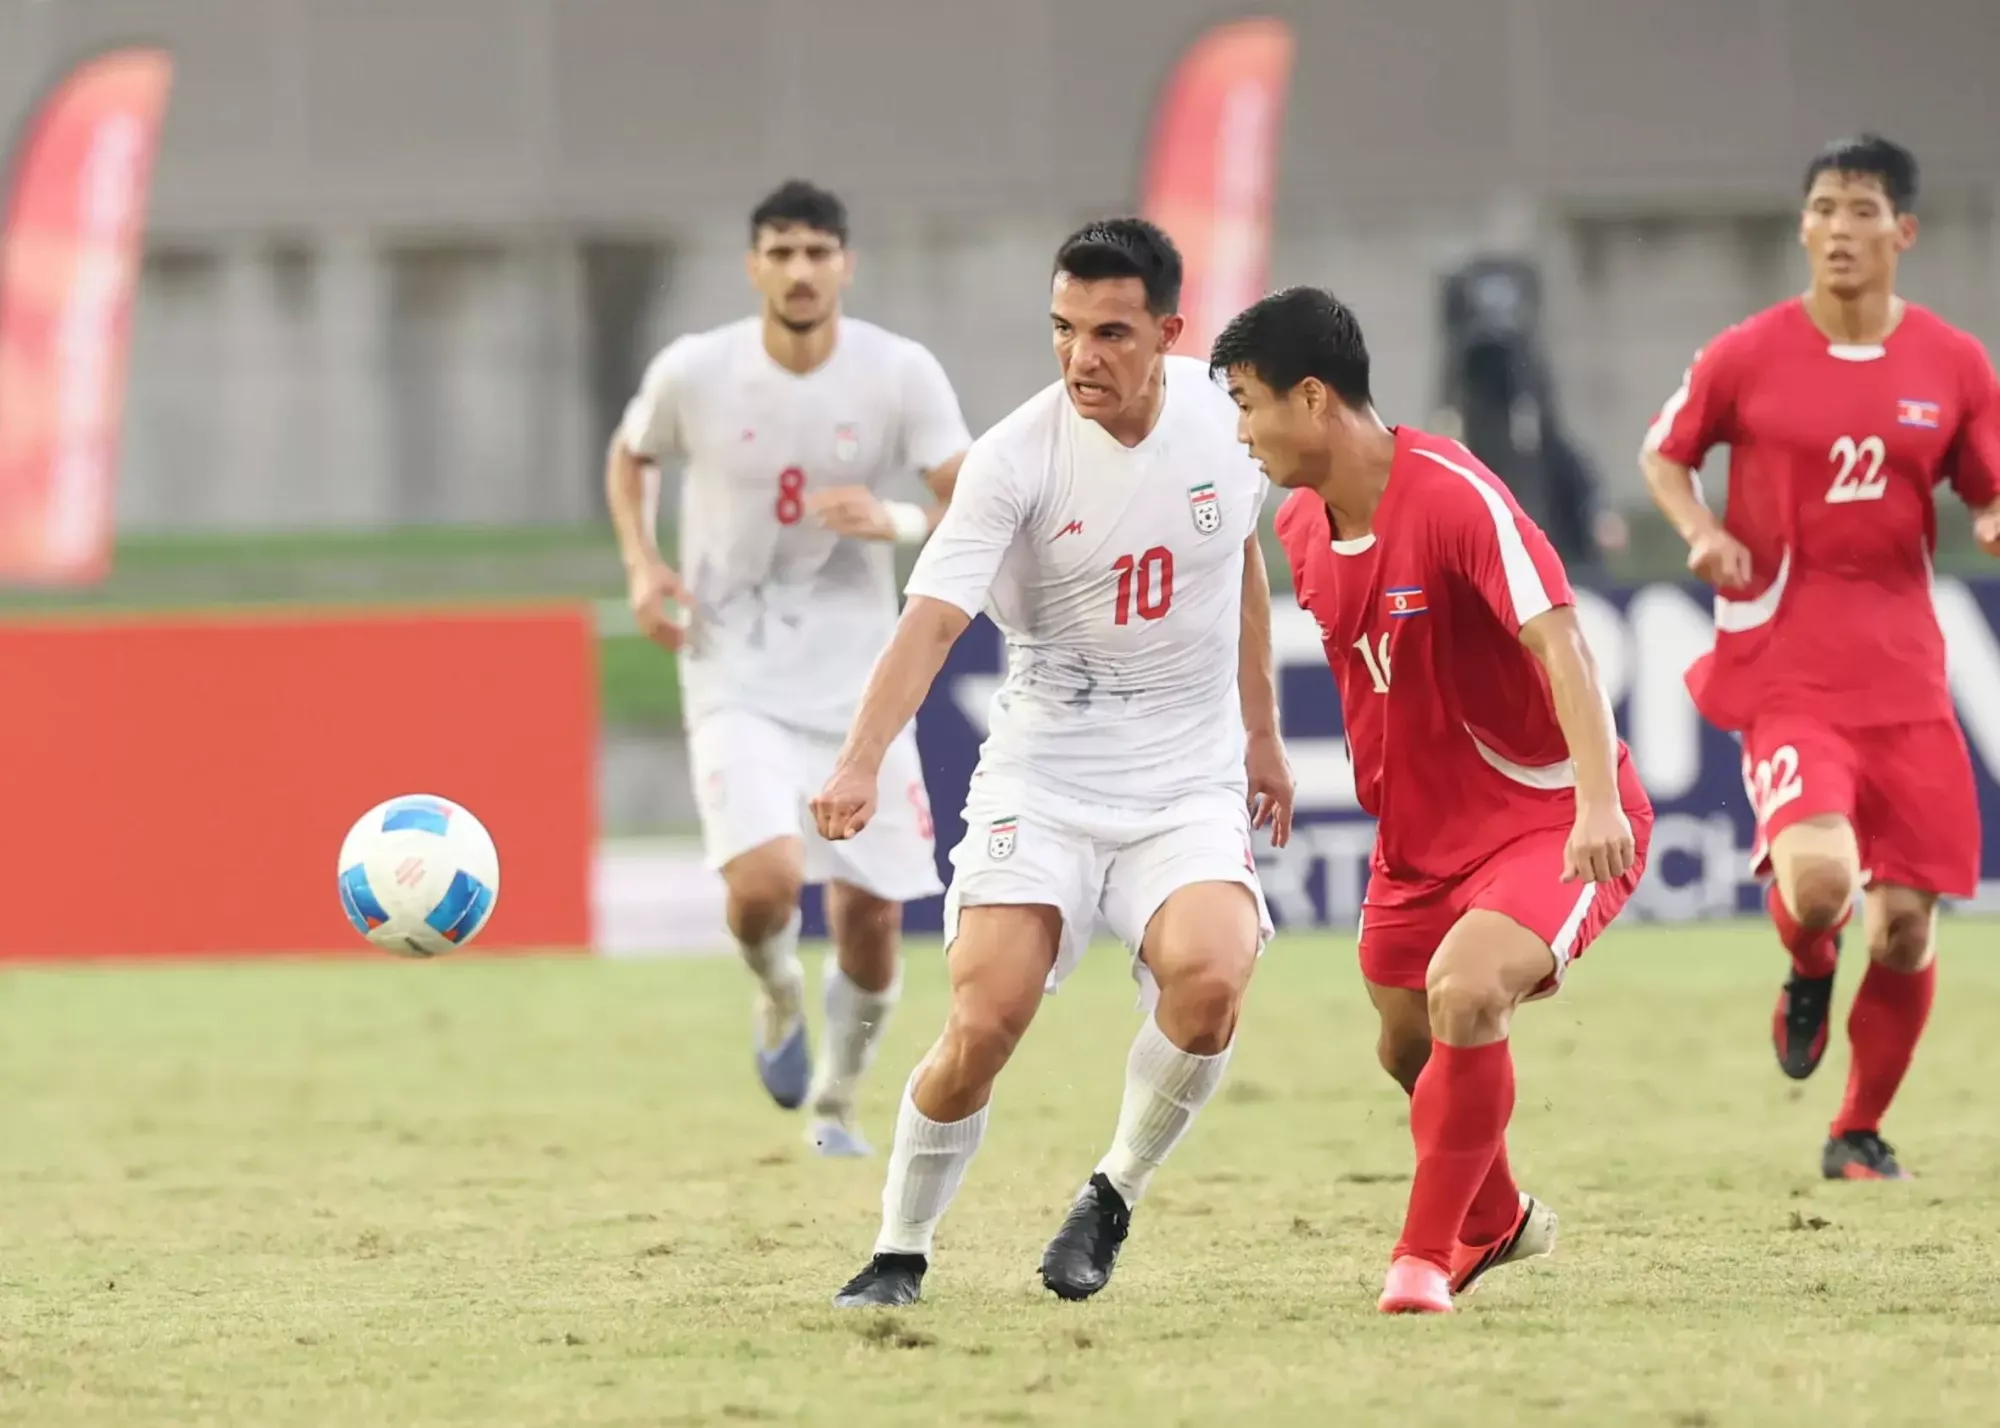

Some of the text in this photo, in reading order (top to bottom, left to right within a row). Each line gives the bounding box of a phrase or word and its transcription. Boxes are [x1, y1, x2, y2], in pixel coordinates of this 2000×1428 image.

[777, 466, 806, 526] 8
[1825, 434, 1887, 504] 22
[1110, 545, 1174, 626] 10
